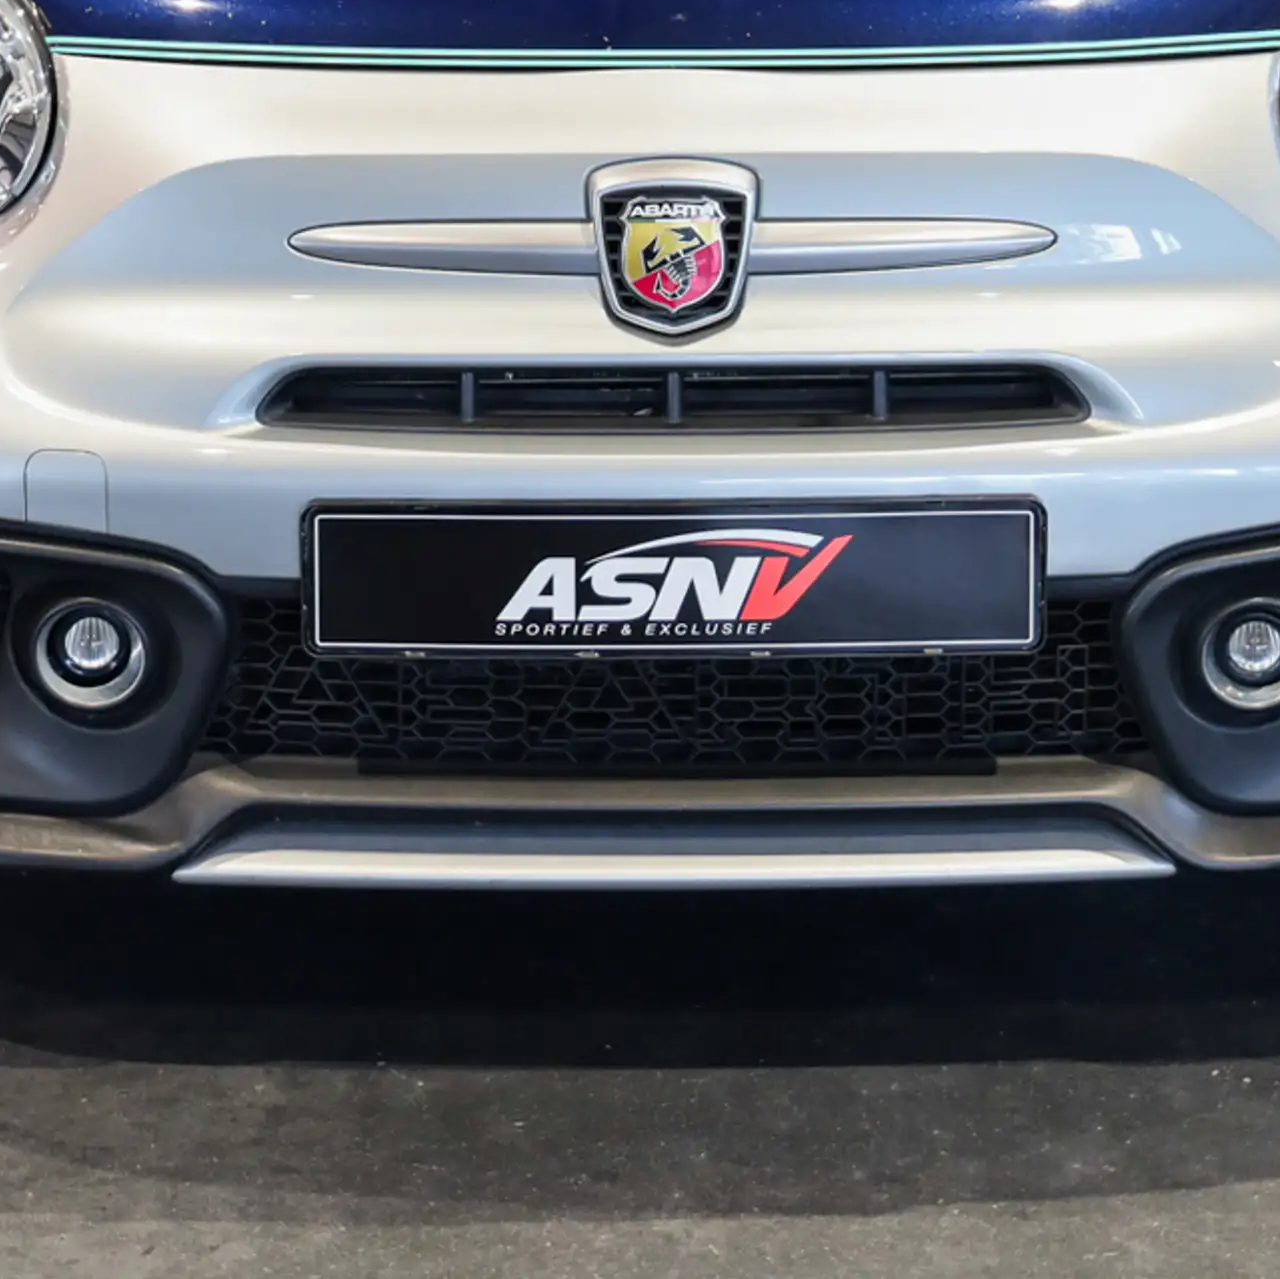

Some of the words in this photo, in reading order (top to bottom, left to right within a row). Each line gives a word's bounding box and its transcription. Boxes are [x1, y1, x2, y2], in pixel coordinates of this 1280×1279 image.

[631, 202, 715, 218] ABARTH
[494, 622, 608, 637] SPORTIEF
[620, 622, 633, 636] &
[644, 621, 773, 636] EXCLUSIEF
